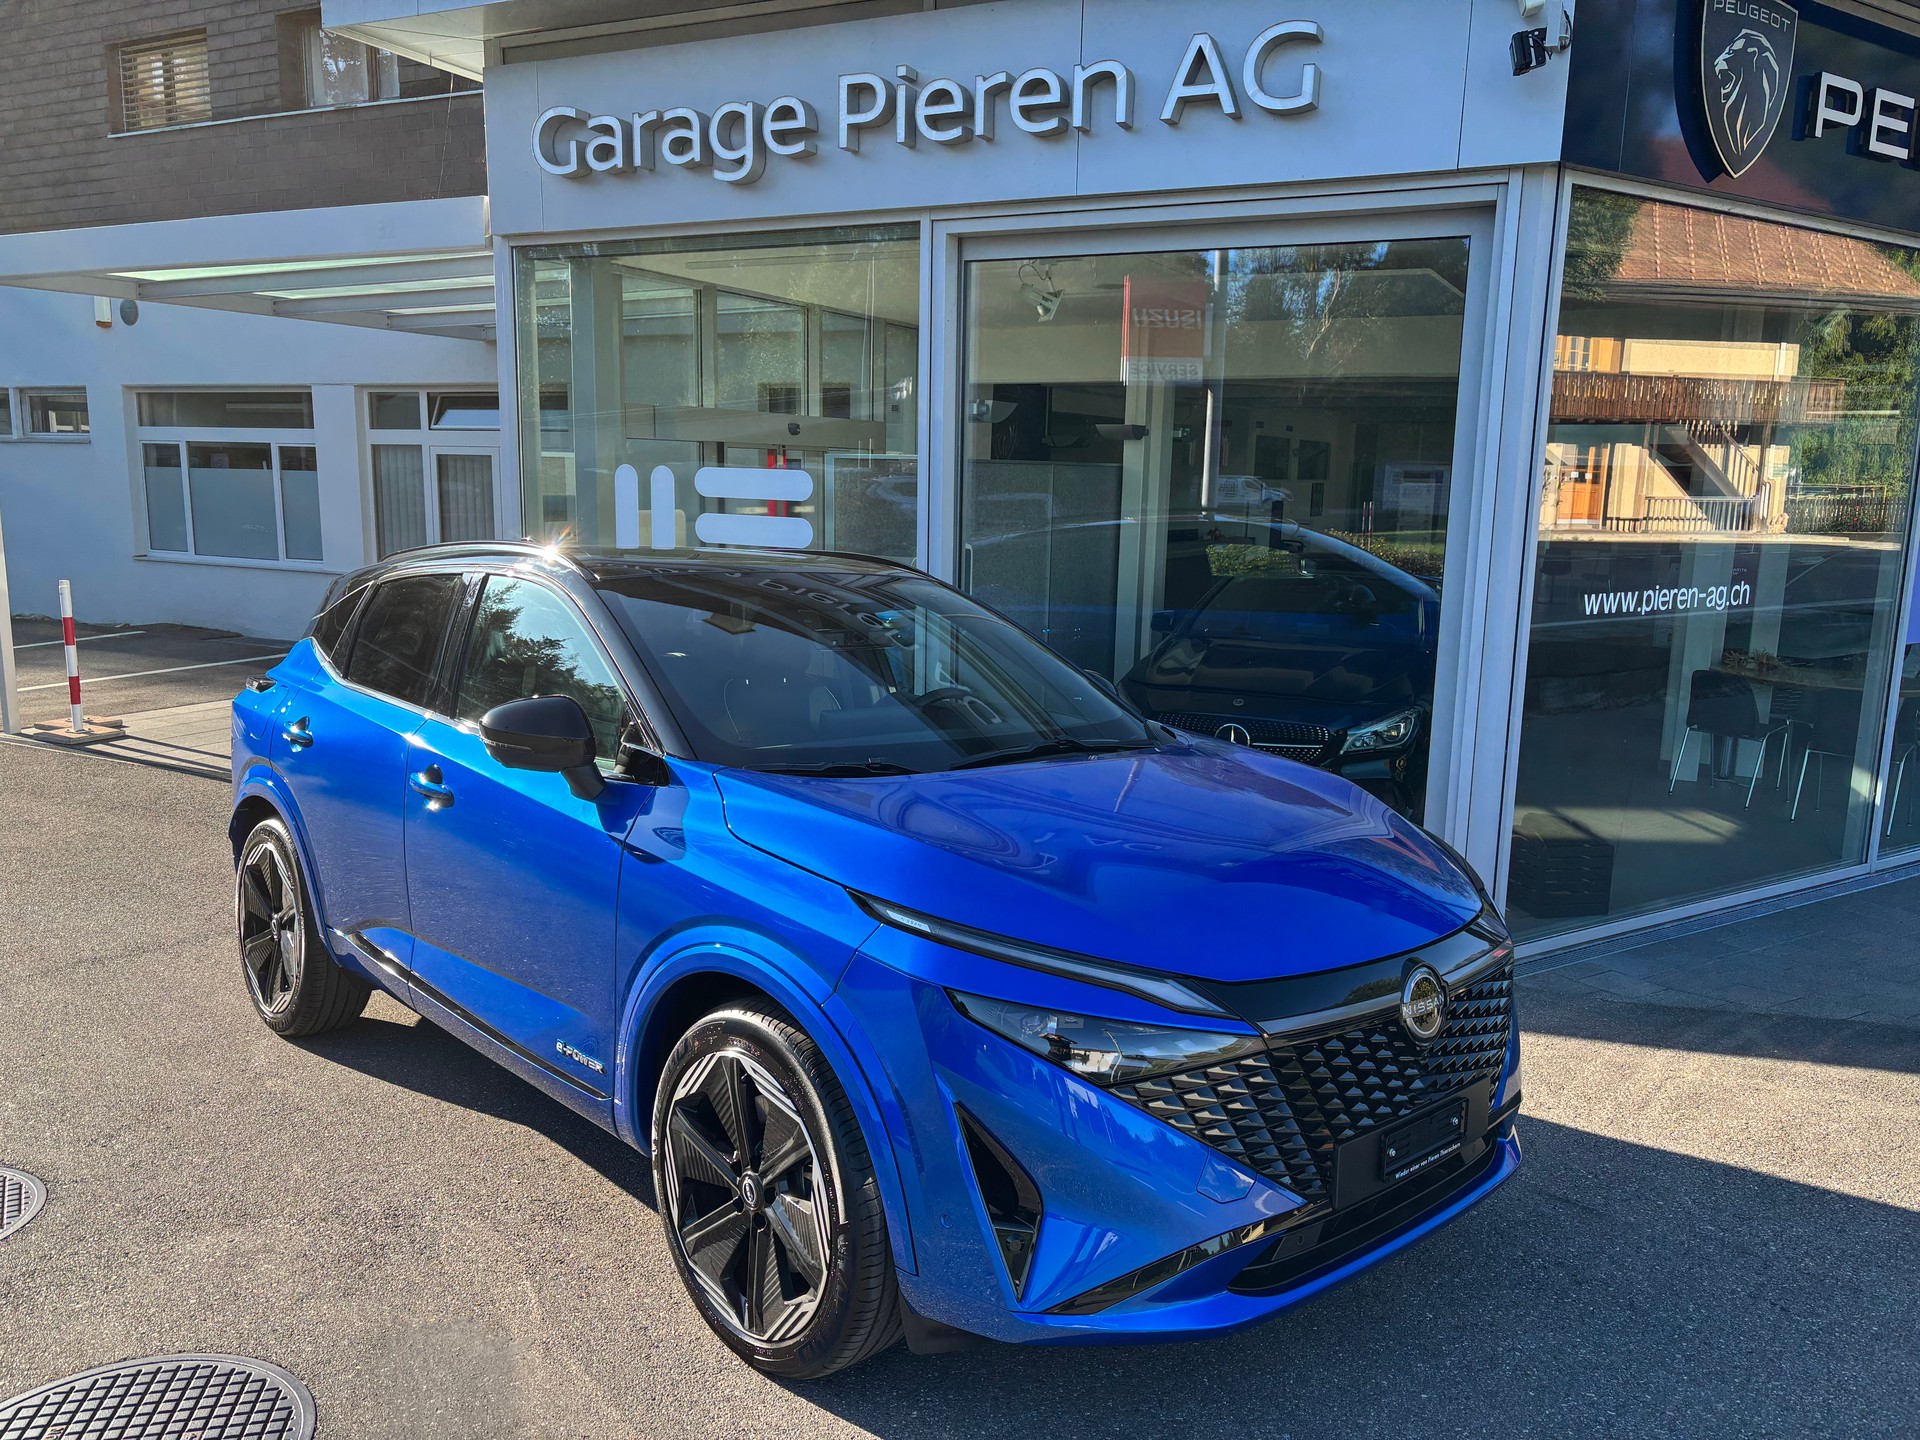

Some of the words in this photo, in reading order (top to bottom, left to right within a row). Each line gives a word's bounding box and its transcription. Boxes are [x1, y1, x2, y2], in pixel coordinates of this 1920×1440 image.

[1713, 0, 1791, 32] PEUGEOT
[532, 96, 818, 186] Garage
[838, 58, 1135, 153] Pieren
[1159, 19, 1323, 126] AG
[1584, 580, 1750, 616] www.pieren-ag.ch
[1402, 992, 1445, 1017] NISSAN
[555, 1040, 606, 1075] e-POWER
